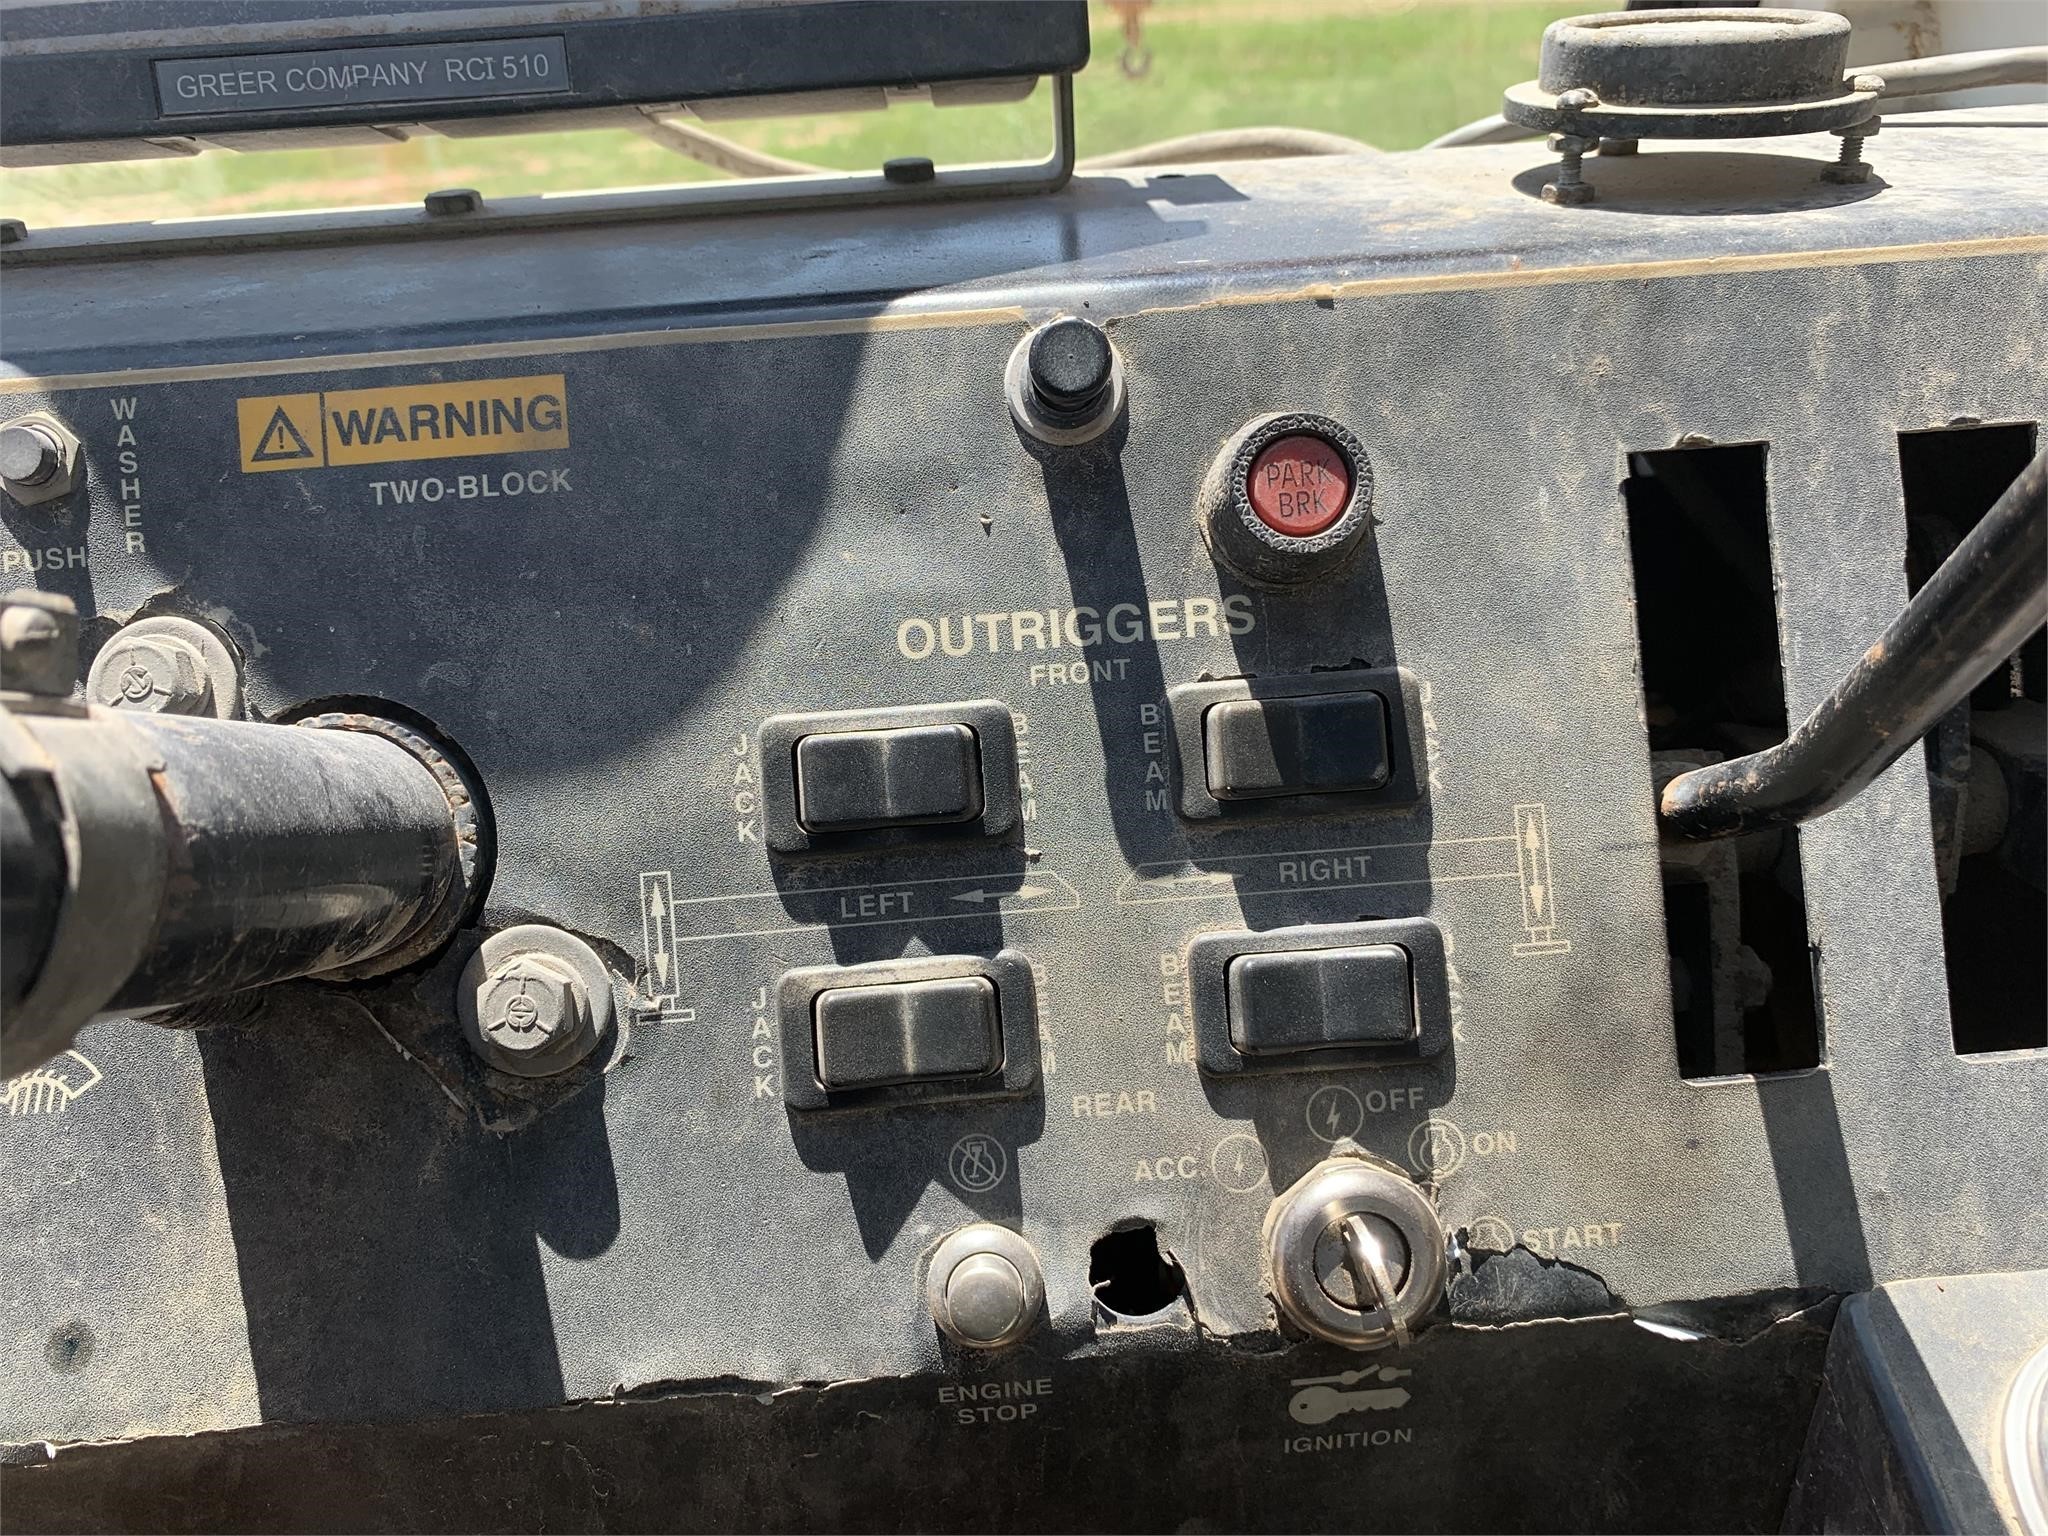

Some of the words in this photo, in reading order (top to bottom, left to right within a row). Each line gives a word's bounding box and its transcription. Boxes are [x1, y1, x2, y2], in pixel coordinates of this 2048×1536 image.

[176, 68, 278, 99] GREER
[285, 60, 427, 93] COMPANY
[445, 56, 497, 82] RCI
[502, 53, 550, 79] 510
[333, 393, 562, 447] WARNING
[110, 397, 146, 554] WASHER
[370, 468, 572, 506] TWO-BLOCK
[1266, 457, 1333, 489] PARK
[1278, 487, 1328, 518] BRK
[2, 546, 87, 573] PUSH
[897, 595, 1256, 660] OUTRIGGERS
[1030, 658, 1131, 687] FRONT
[1140, 703, 1168, 812] BEAM
[734, 734, 759, 843] JACK
[1279, 855, 1371, 884] RIGHT
[840, 892, 914, 919] LEFT
[1160, 953, 1189, 1064] BEAM
[752, 987, 775, 1099] JACK
[1072, 1091, 1157, 1118] REAR
[1365, 1087, 1424, 1114] OFF
[1472, 1131, 1516, 1156] ON
[1521, 1222, 1622, 1252] START
[938, 1378, 1053, 1403] ENGINE
[957, 1403, 1038, 1424] STOP
[1284, 1428, 1413, 1454] IGNITION
